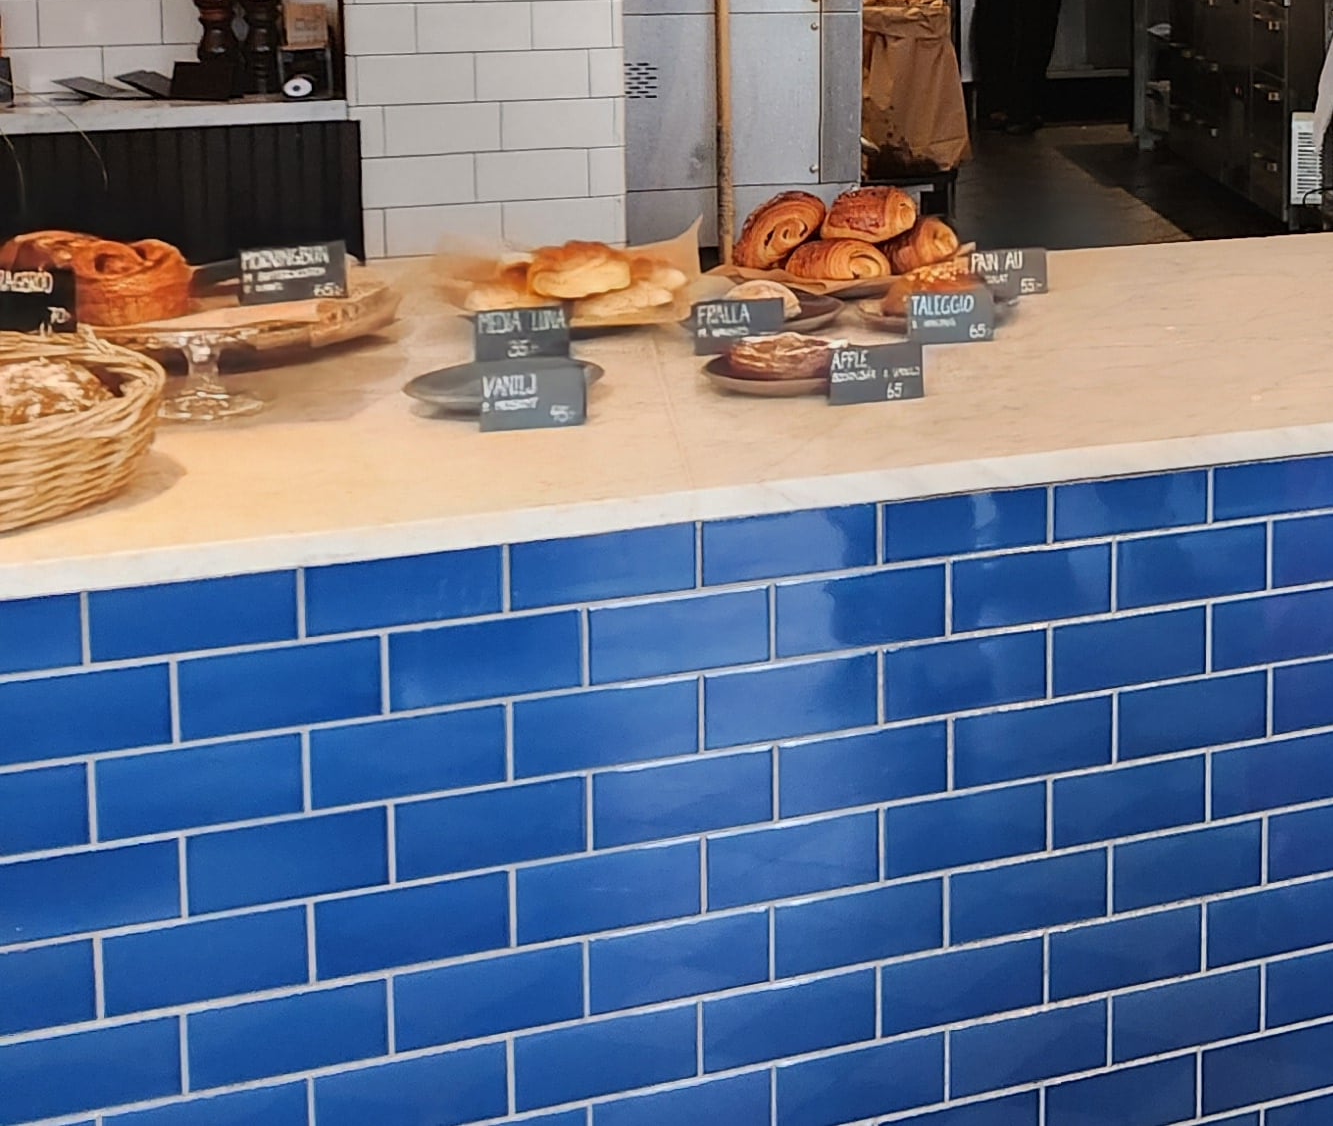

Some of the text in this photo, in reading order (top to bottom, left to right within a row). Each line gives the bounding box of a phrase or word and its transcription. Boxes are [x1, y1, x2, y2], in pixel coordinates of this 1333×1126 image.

[1004, 250, 1023, 271] AU
[910, 294, 975, 316] TALEGGIO
[482, 373, 537, 399] VANILJ
